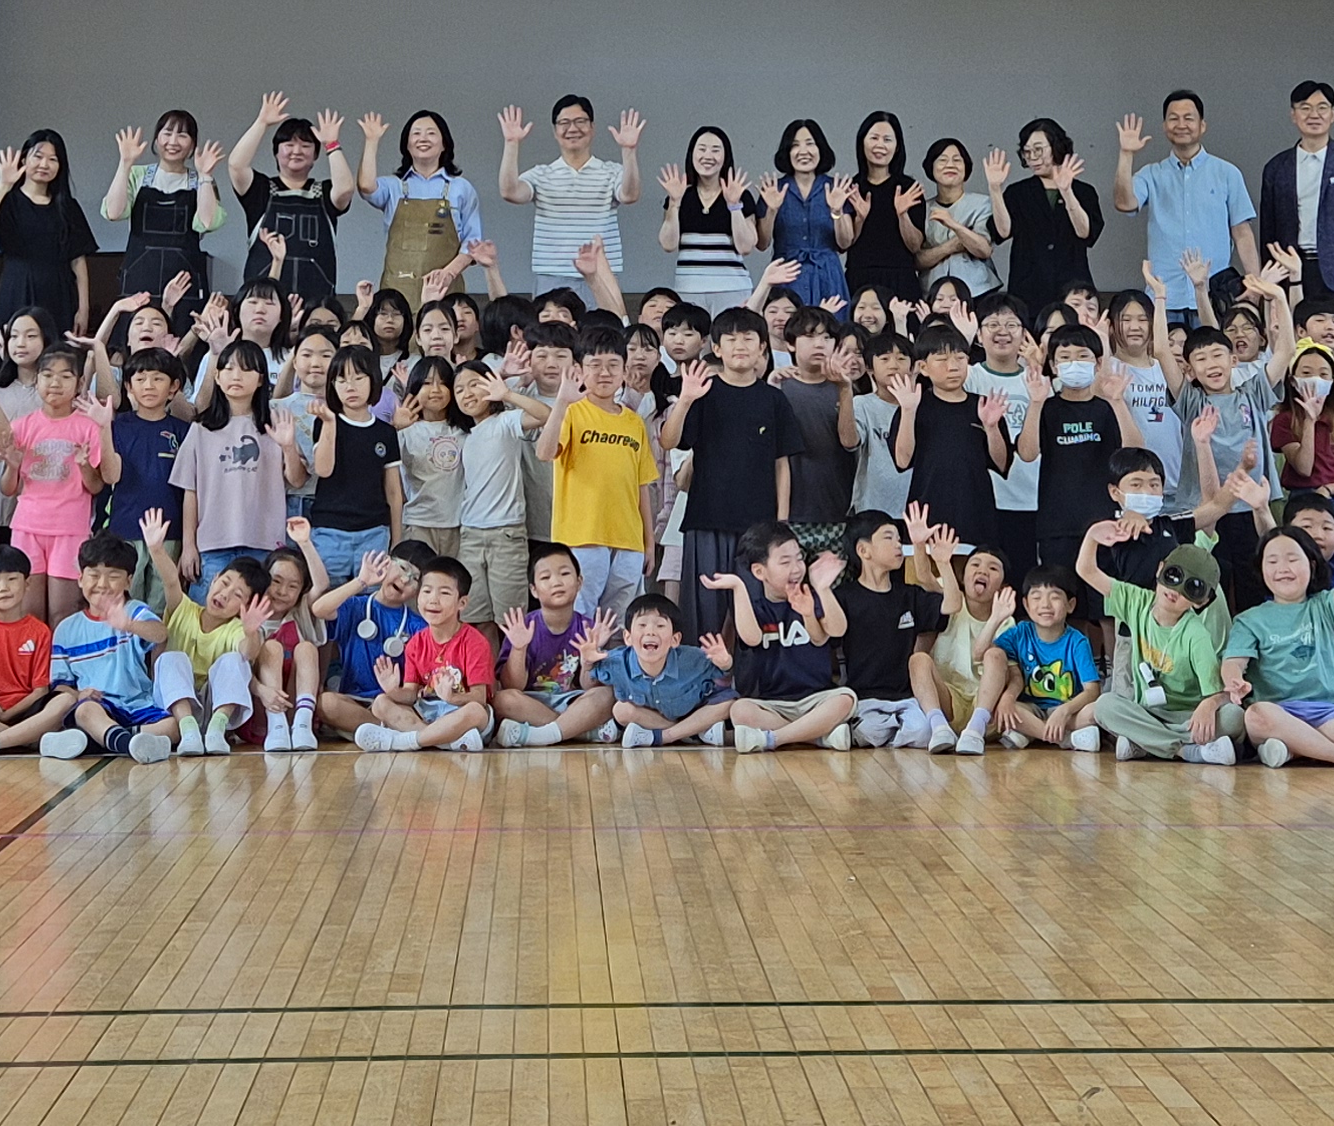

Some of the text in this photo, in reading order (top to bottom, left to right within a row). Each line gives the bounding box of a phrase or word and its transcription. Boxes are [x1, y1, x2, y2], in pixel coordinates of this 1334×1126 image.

[1130, 383, 1166, 393] TOMM
[1132, 395, 1168, 408] HILFIG
[1063, 421, 1094, 434] POLE
